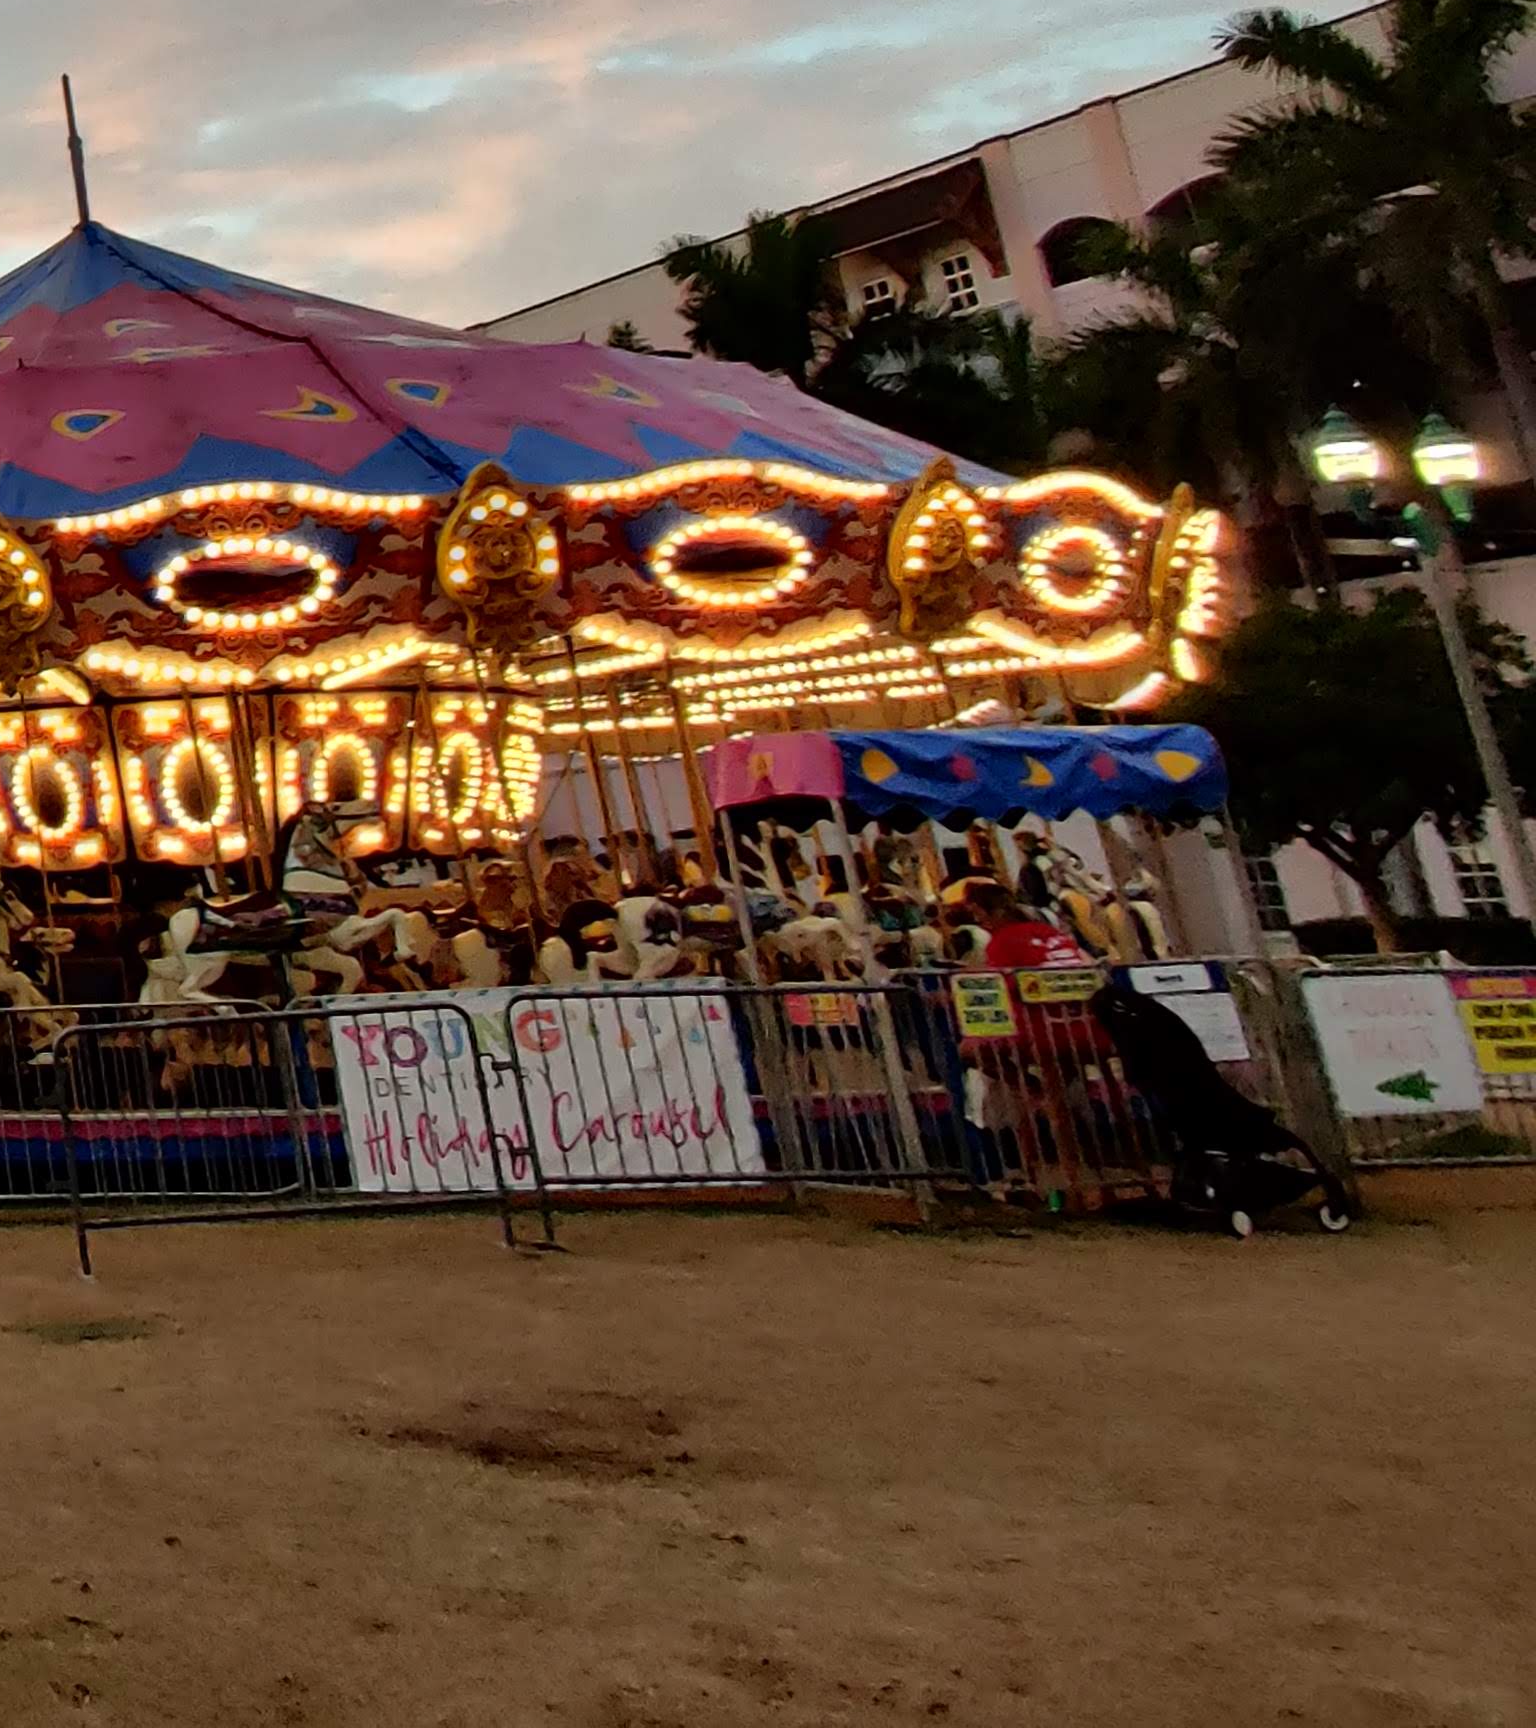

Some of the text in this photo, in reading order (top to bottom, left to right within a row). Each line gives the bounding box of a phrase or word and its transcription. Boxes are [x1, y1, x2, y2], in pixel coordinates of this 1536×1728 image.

[341, 1009, 561, 1068] YOUNG
[363, 1085, 728, 1181] Holiday Carousel
